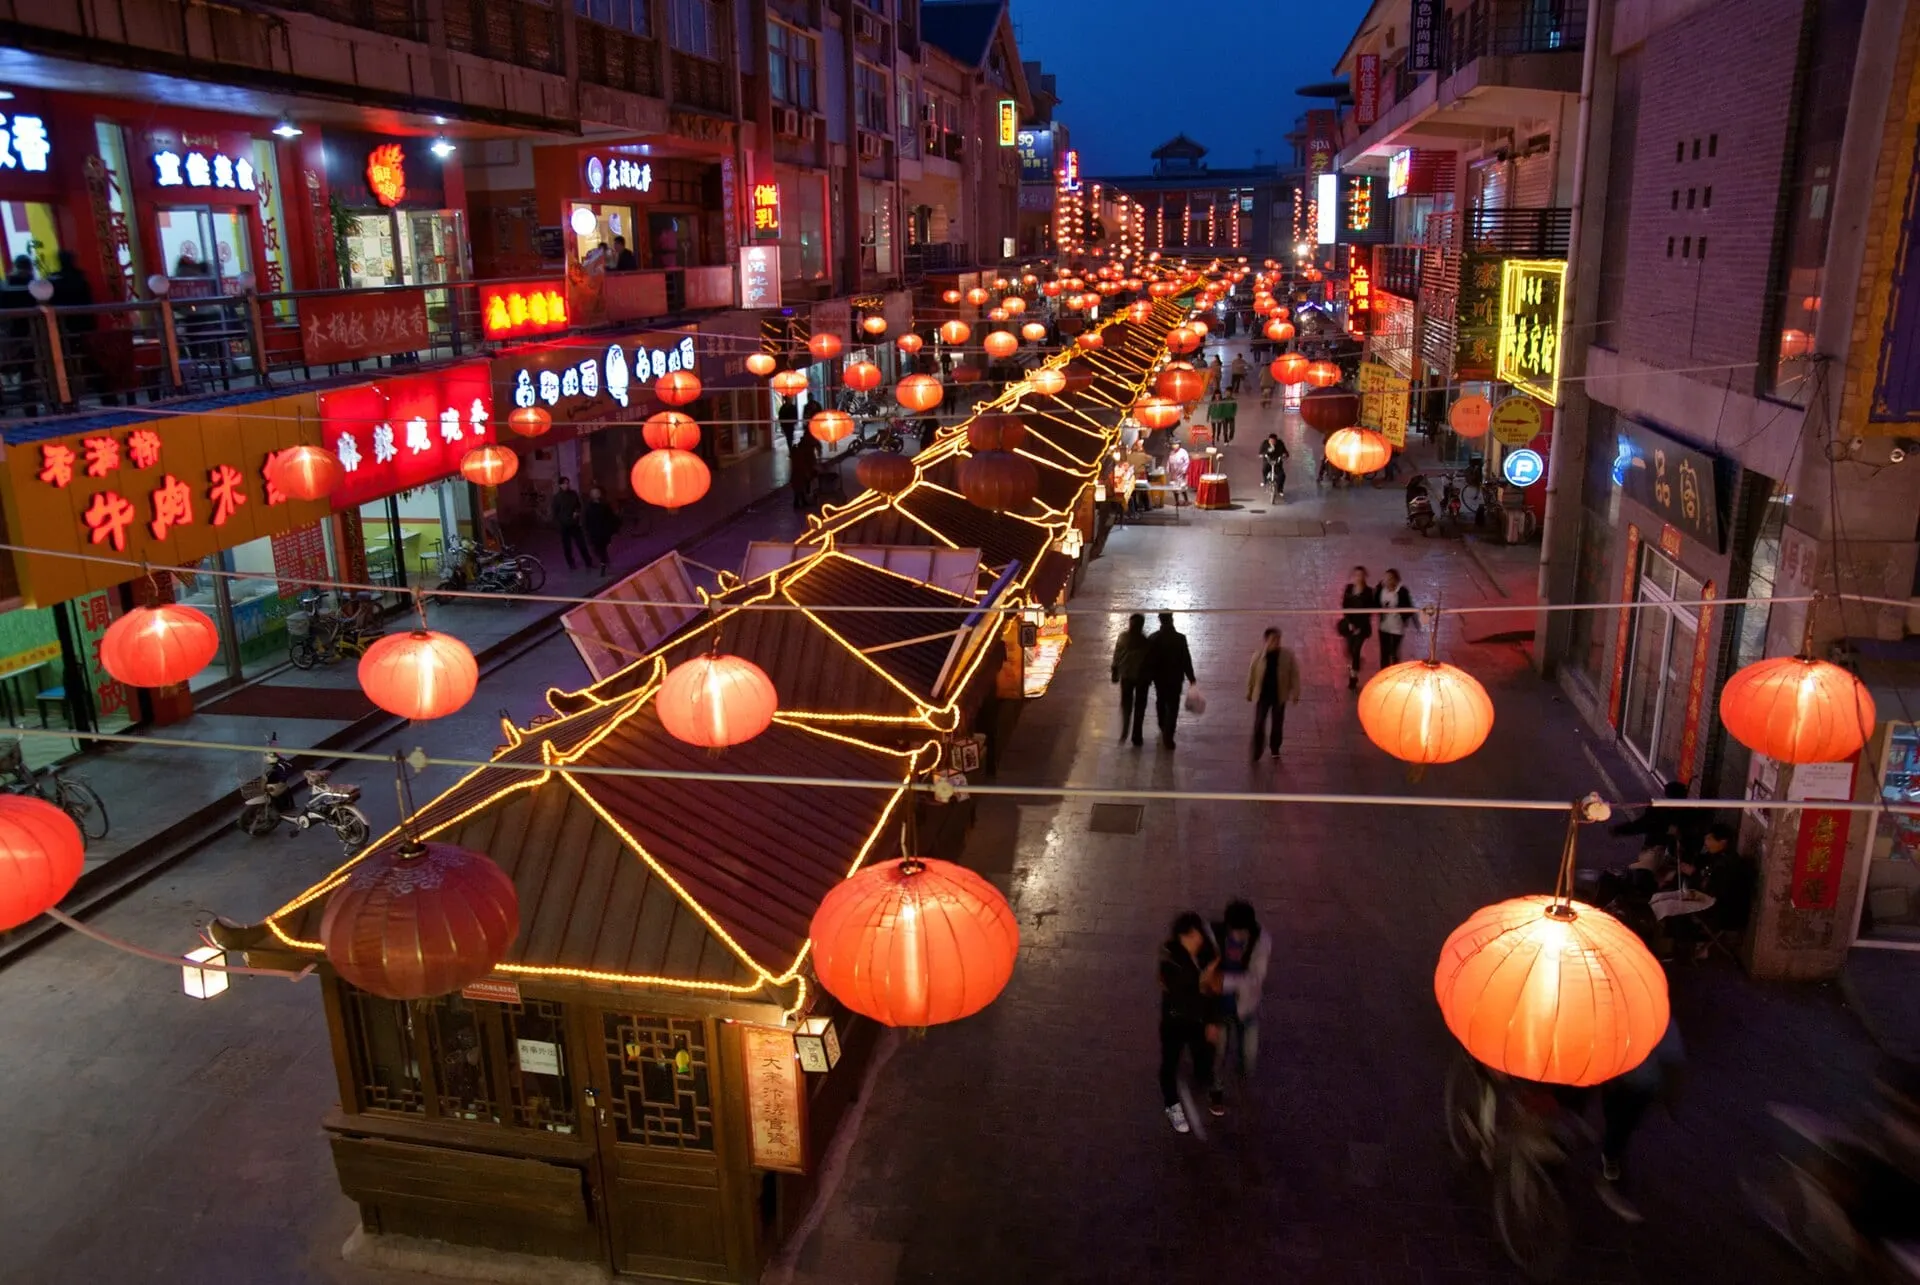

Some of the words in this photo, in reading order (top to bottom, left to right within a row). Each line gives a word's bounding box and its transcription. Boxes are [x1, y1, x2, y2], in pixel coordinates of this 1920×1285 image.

[753, 183, 779, 230] 催乳
[306, 312, 369, 349] 木桶饭
[373, 305, 428, 342] 炒饭香
[1515, 460, 1533, 476] P
